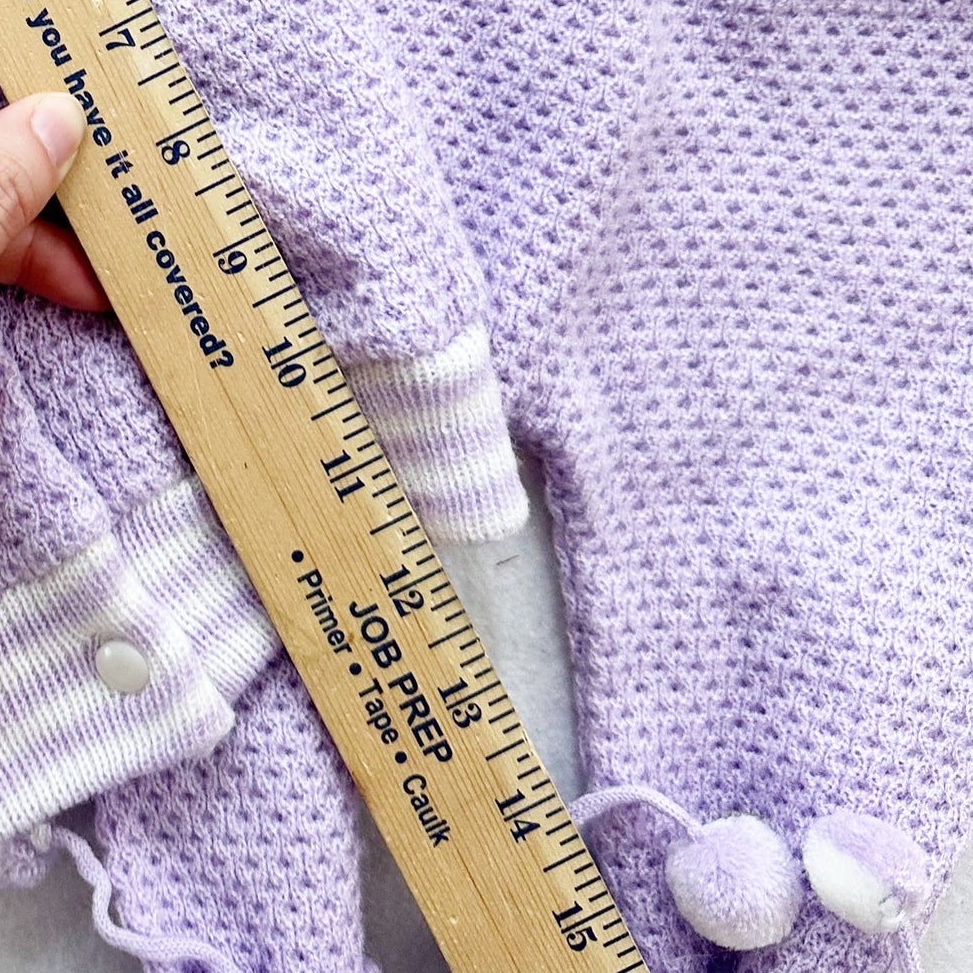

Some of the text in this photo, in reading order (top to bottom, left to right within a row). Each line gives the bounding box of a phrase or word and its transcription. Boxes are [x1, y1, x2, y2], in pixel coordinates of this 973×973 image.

[105, 27, 136, 51] 7
[161, 139, 191, 166] 8
[25, 7, 73, 67] you
[63, 68, 112, 148] have
[105, 149, 134, 180] it
[121, 183, 159, 225] all
[146, 230, 235, 370] covered?
[217, 250, 248, 275] 9
[261, 336, 307, 389] 10
[320, 449, 366, 504] 11
[379, 564, 425, 619] 12
[296, 568, 451, 848] Primer Tape Caulk
[348, 601, 454, 764] JOB PREP
[437, 676, 483, 729] 13
[494, 788, 541, 844] 14
[551, 900, 598, 953] 15
